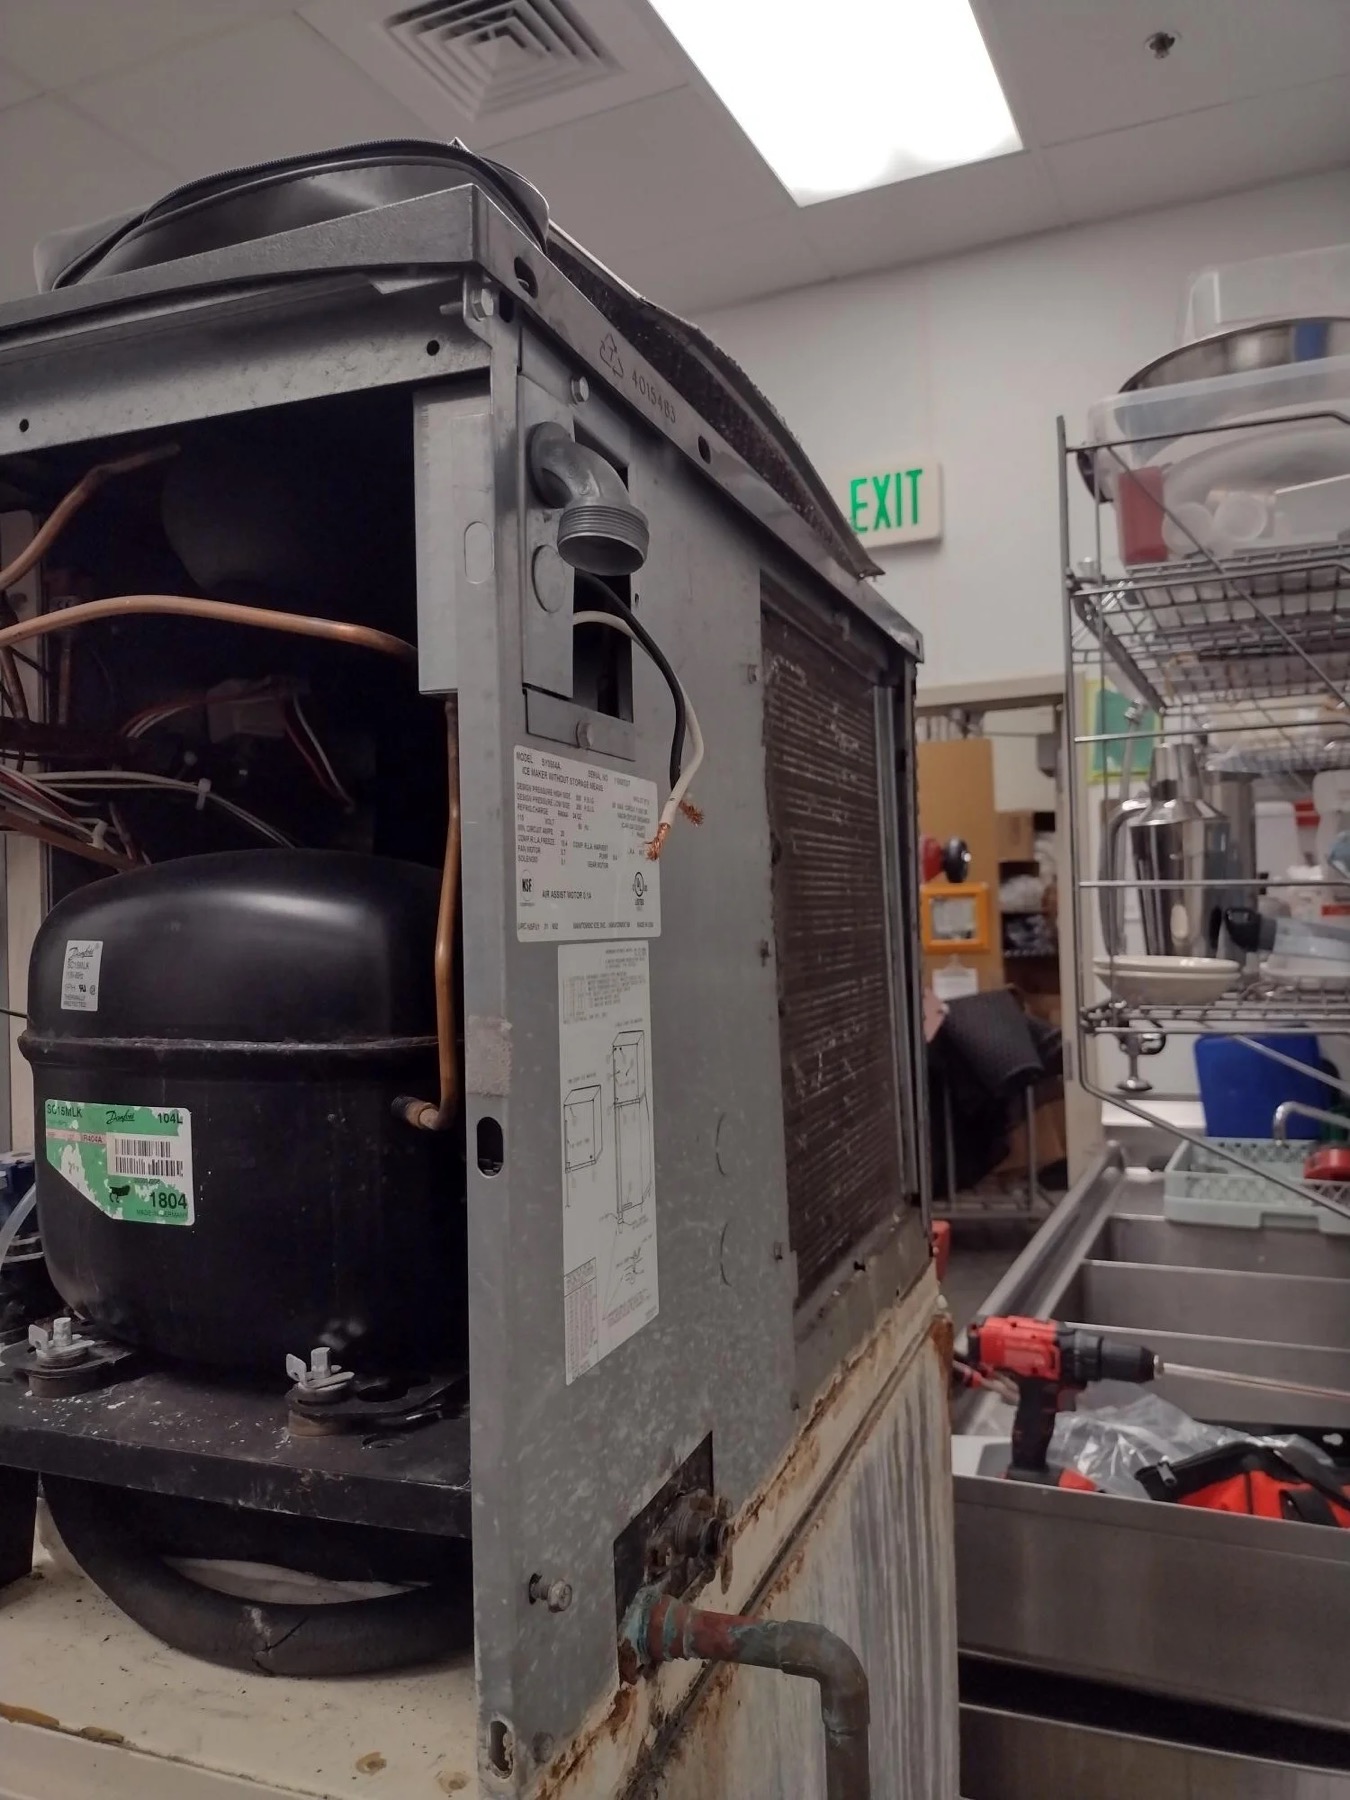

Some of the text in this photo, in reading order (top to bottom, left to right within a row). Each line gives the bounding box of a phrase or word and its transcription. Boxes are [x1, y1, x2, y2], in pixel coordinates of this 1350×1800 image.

[631, 368, 676, 424] 4015483
[850, 468, 923, 533] EXIT
[516, 751, 534, 764] MODEL
[522, 766, 530, 776] ICE
[531, 768, 548, 780] MAKER
[548, 772, 569, 785] WITHOUT
[569, 777, 589, 789] STORAGE
[590, 781, 604, 792] MEANS
[532, 785, 553, 796] PRESSURE
[532, 796, 553, 807] PRESSURE
[527, 846, 541, 854] MOTOR
[542, 890, 550, 898] AIR
[550, 890, 566, 899] ASSIST
[567, 891, 583, 899] MOTOR
[46, 1104, 83, 1118] SC15MLK
[105, 1109, 135, 1125] Danfoss
[157, 1112, 184, 1124] 104L
[83, 1134, 103, 1143] R404A
[150, 1191, 188, 1209] 1804
